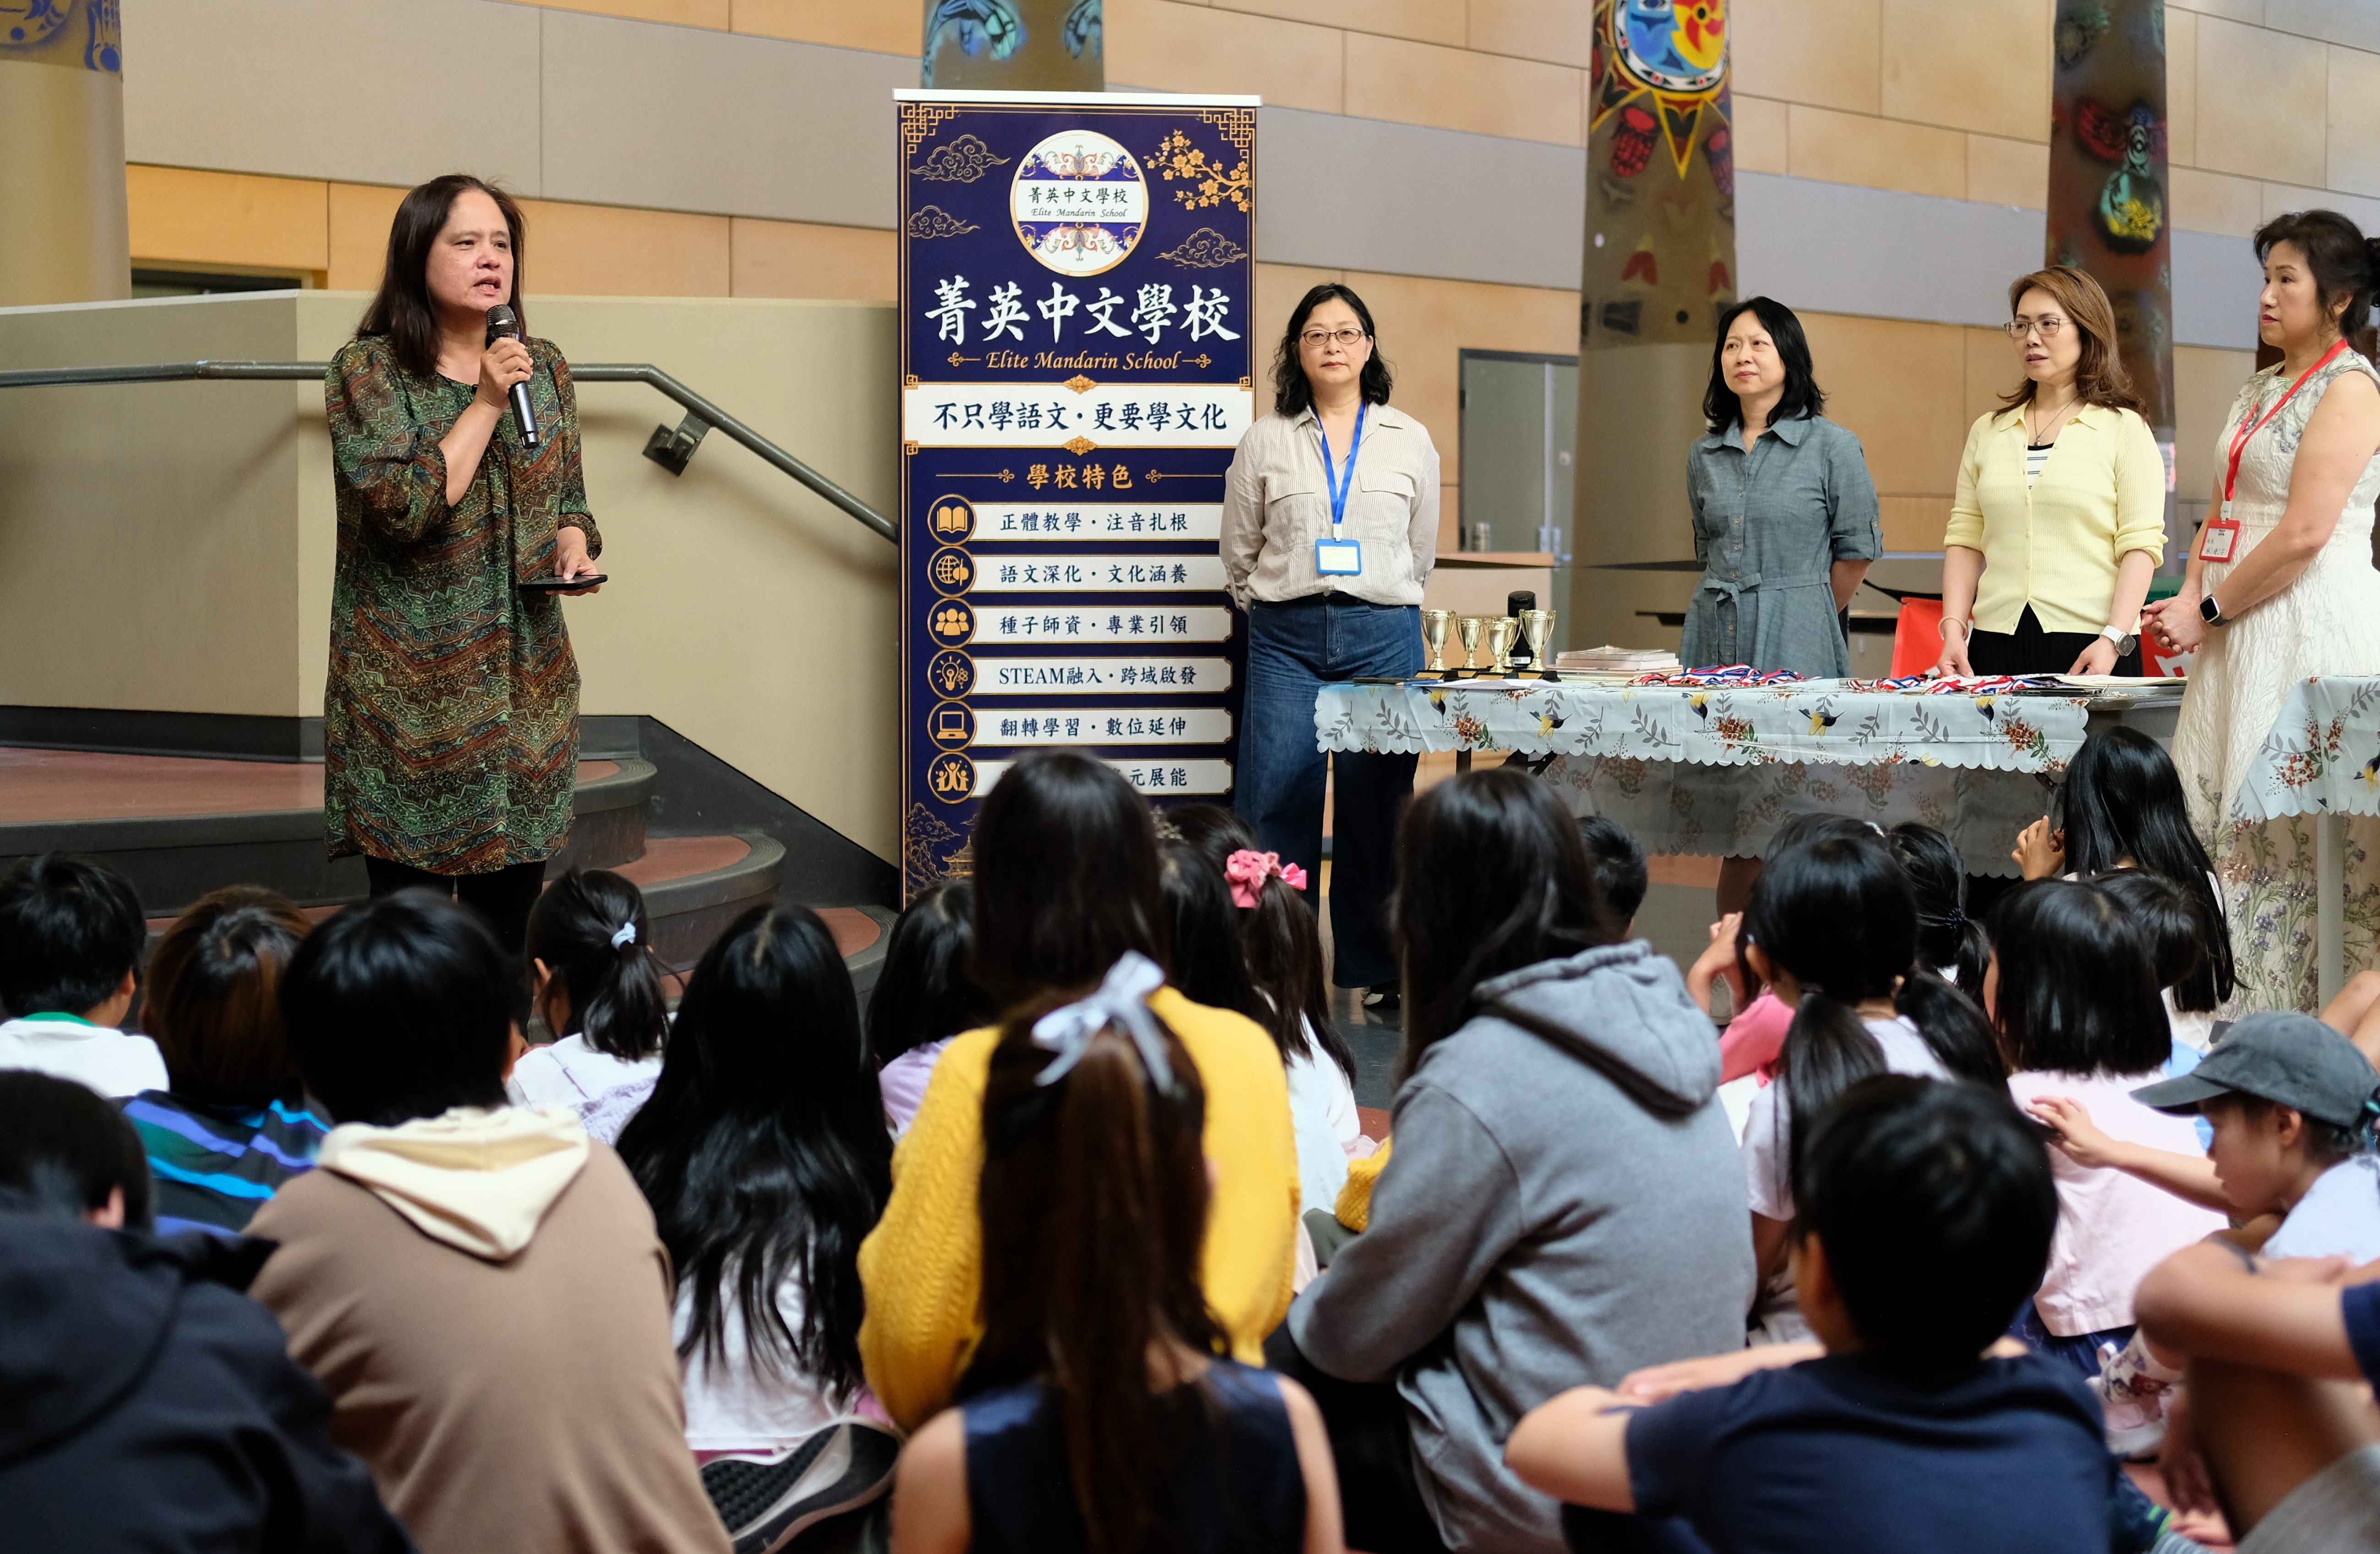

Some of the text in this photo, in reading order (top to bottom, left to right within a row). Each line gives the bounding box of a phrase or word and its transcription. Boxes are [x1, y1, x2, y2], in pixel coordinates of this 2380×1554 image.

[1028, 186, 1128, 204] 菁英中文學校
[1031, 207, 1128, 217] Elite Mandarin School
[925, 276, 1240, 345] 菁英中文學校
[986, 350, 1181, 370] Elite Mandarin School
[1027, 464, 1133, 490] 學校特色
